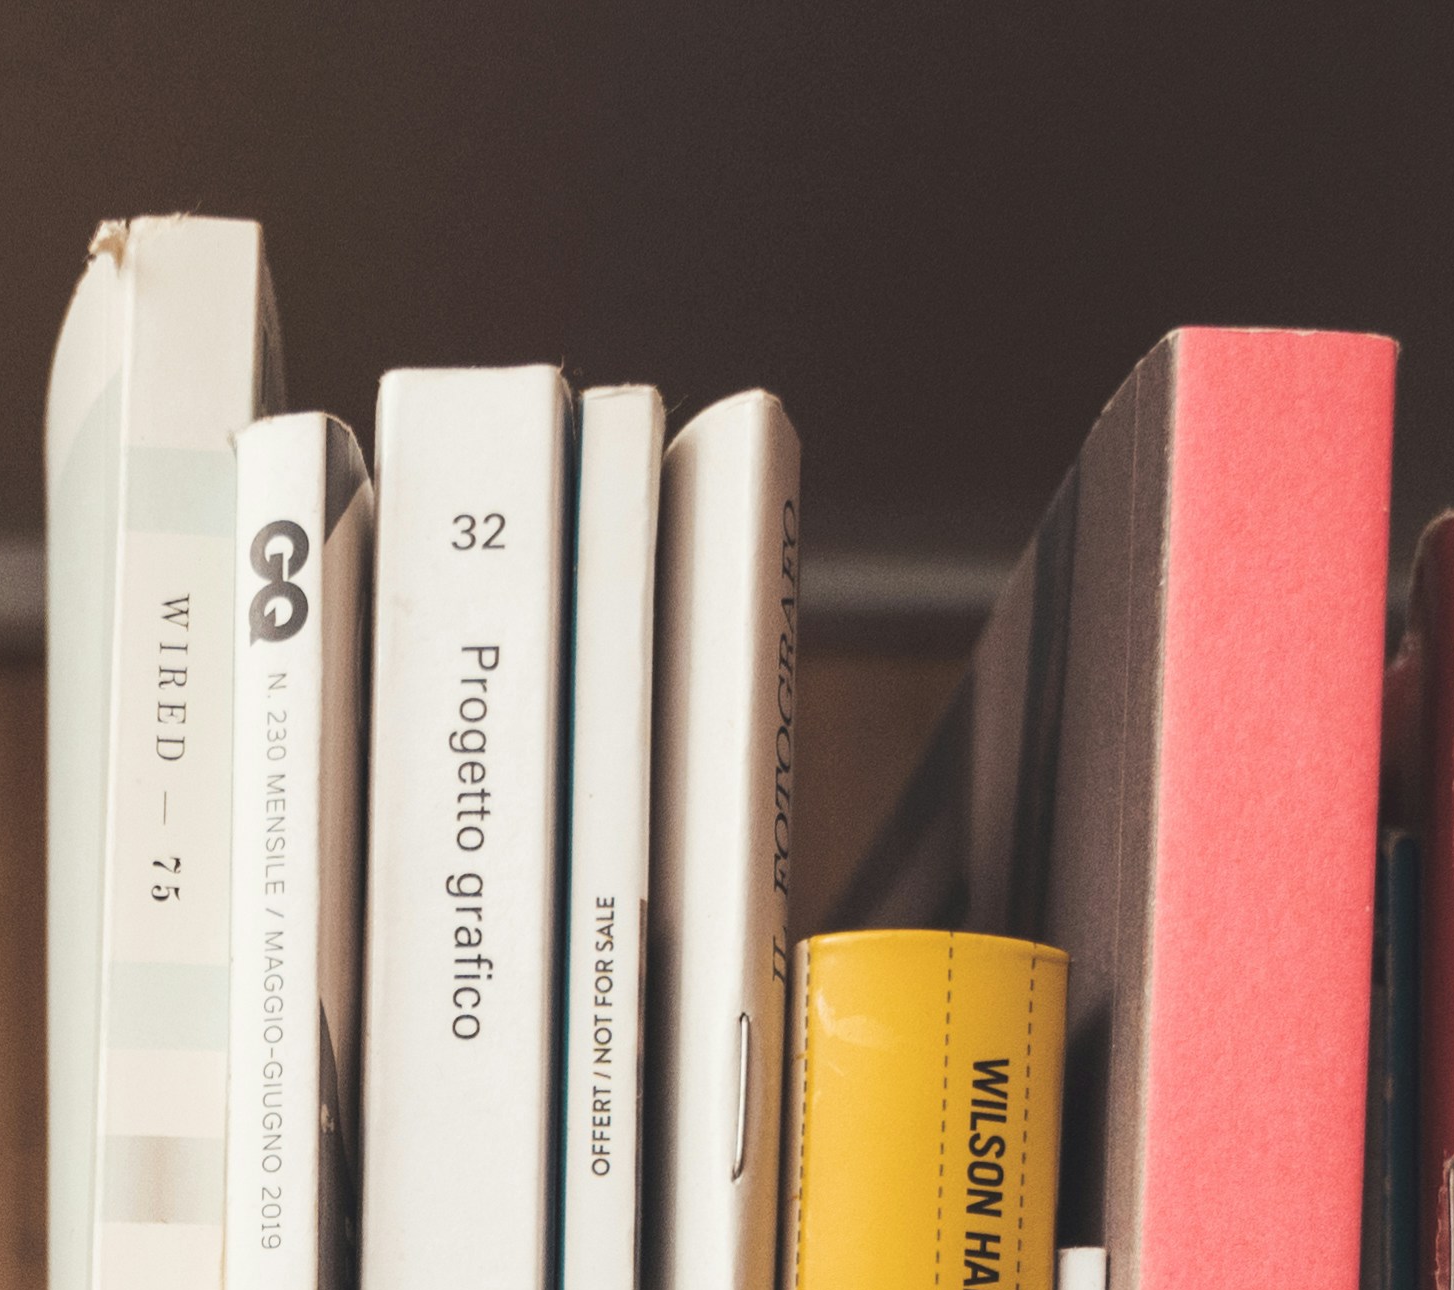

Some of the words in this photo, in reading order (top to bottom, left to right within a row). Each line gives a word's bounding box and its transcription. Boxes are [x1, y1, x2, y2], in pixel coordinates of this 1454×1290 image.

[450, 514, 507, 551] 32
[249, 520, 310, 646] GQ
[155, 593, 190, 762] WIRED
[266, 671, 288, 698] N.
[773, 497, 798, 898] FOTOGRAFO
[265, 709, 288, 761] 230
[447, 644, 500, 852] Progetto
[263, 772, 287, 895] MENSILE
[150, 856, 182, 902] 75
[444, 871, 494, 1040] grafico
[593, 895, 615, 952] SALE
[773, 926, 789, 986] IL
[593, 958, 614, 1007] FOR
[260, 929, 285, 1174] MAGGIO-GIUGNO
[592, 1013, 613, 1064] NOT
[590, 1084, 612, 1177] OFFERT
[970, 1057, 1011, 1217] WILSON
[259, 1185, 283, 1250] 2019
